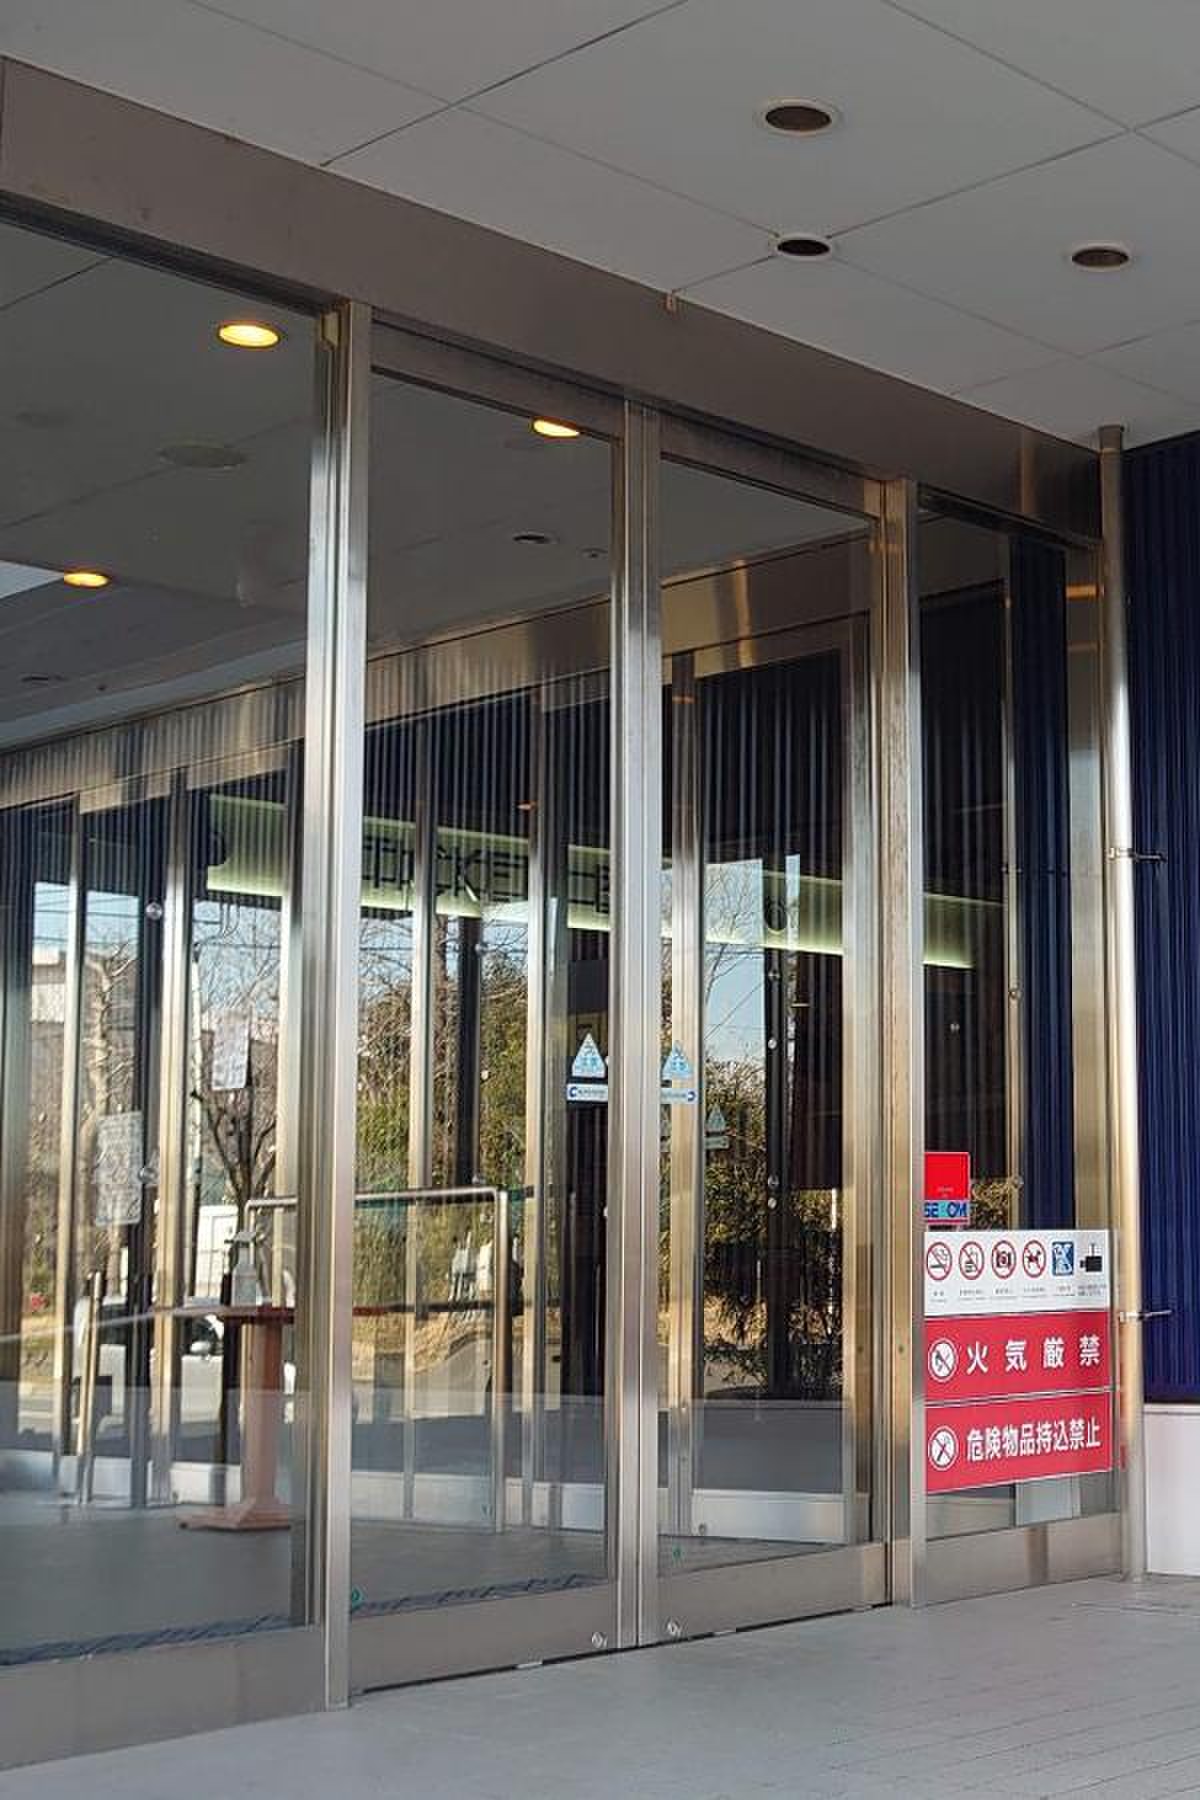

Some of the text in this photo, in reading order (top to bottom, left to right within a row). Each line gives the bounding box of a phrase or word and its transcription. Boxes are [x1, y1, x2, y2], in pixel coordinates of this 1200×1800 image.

[967, 1335, 1100, 1373] 火気厳禁
[966, 1418, 1100, 1462] 危険物品持込禁止
